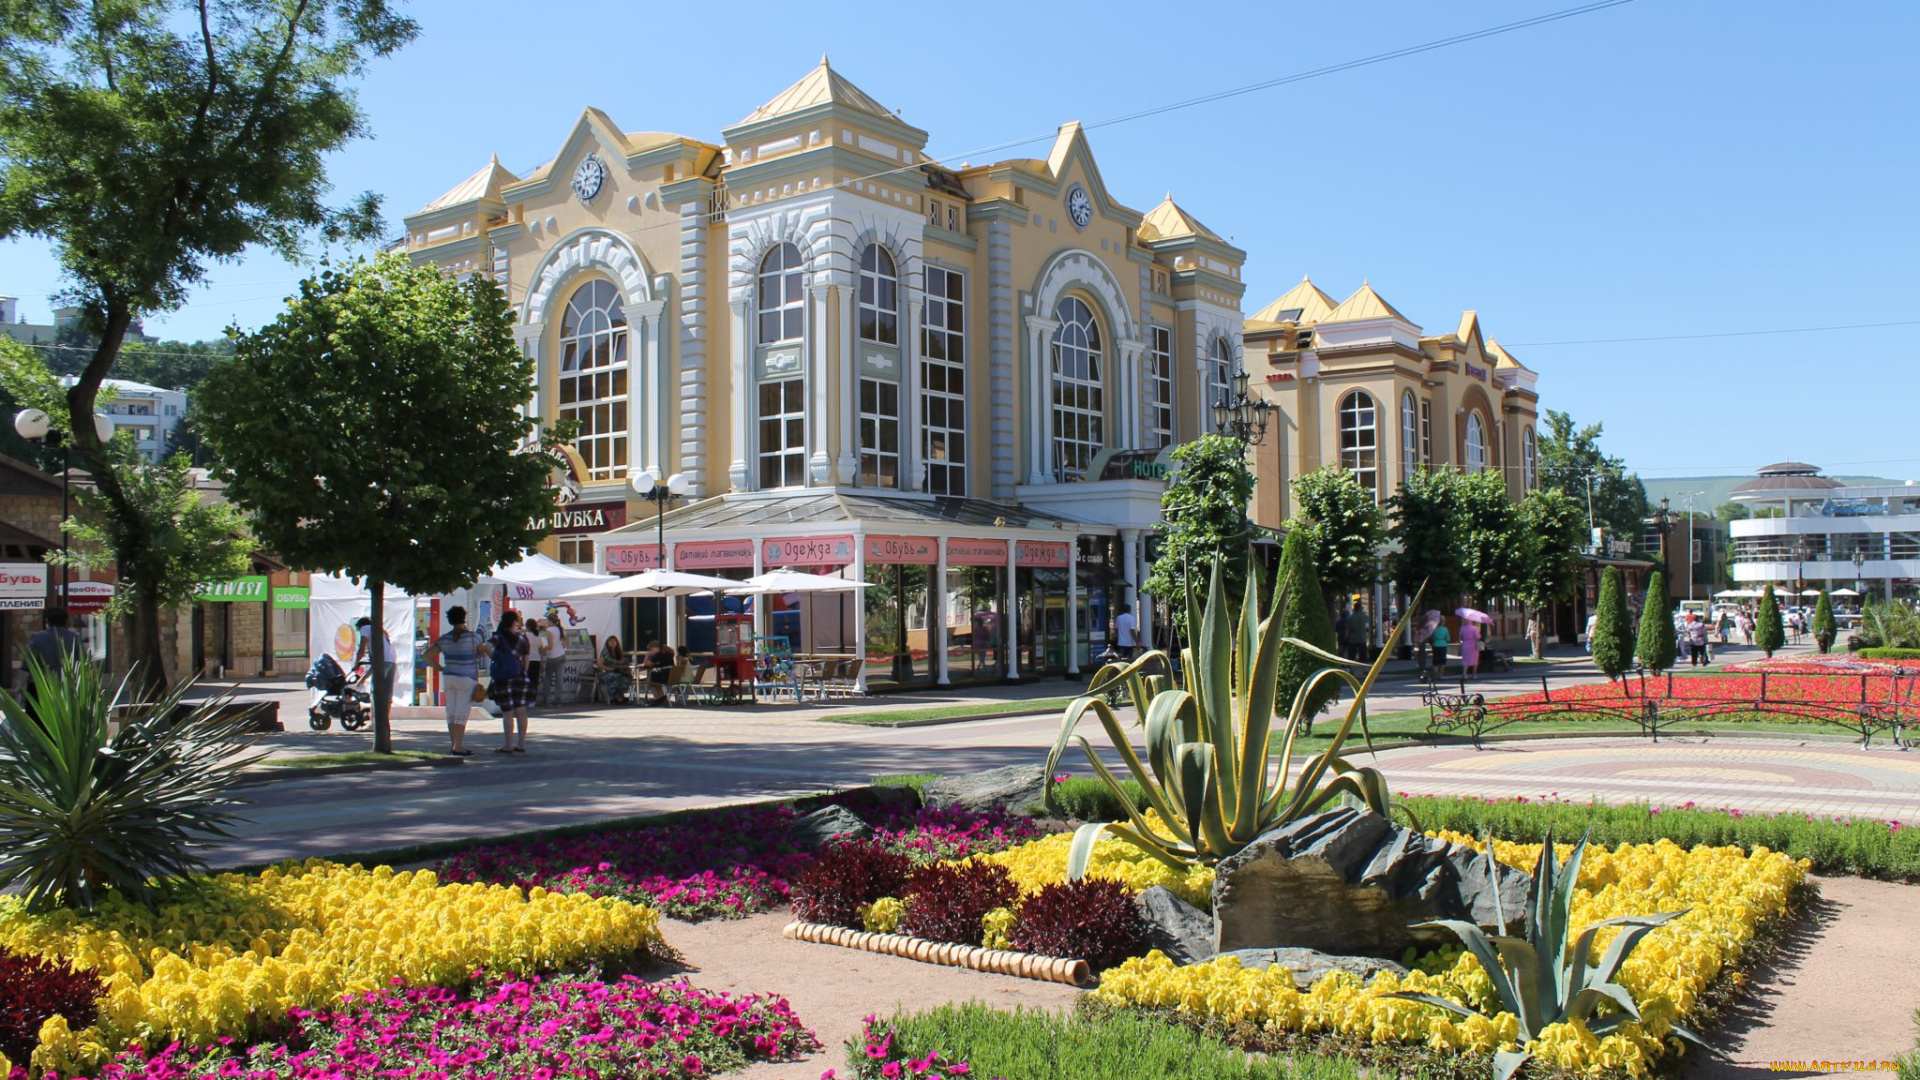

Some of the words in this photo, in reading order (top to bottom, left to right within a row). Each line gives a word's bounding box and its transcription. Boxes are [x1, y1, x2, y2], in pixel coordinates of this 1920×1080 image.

[1134, 459, 1166, 478] HOTE
[785, 540, 831, 561] Одежда
[1024, 544, 1056, 563] Одежда
[276, 593, 306, 603] ОБУВЬ
